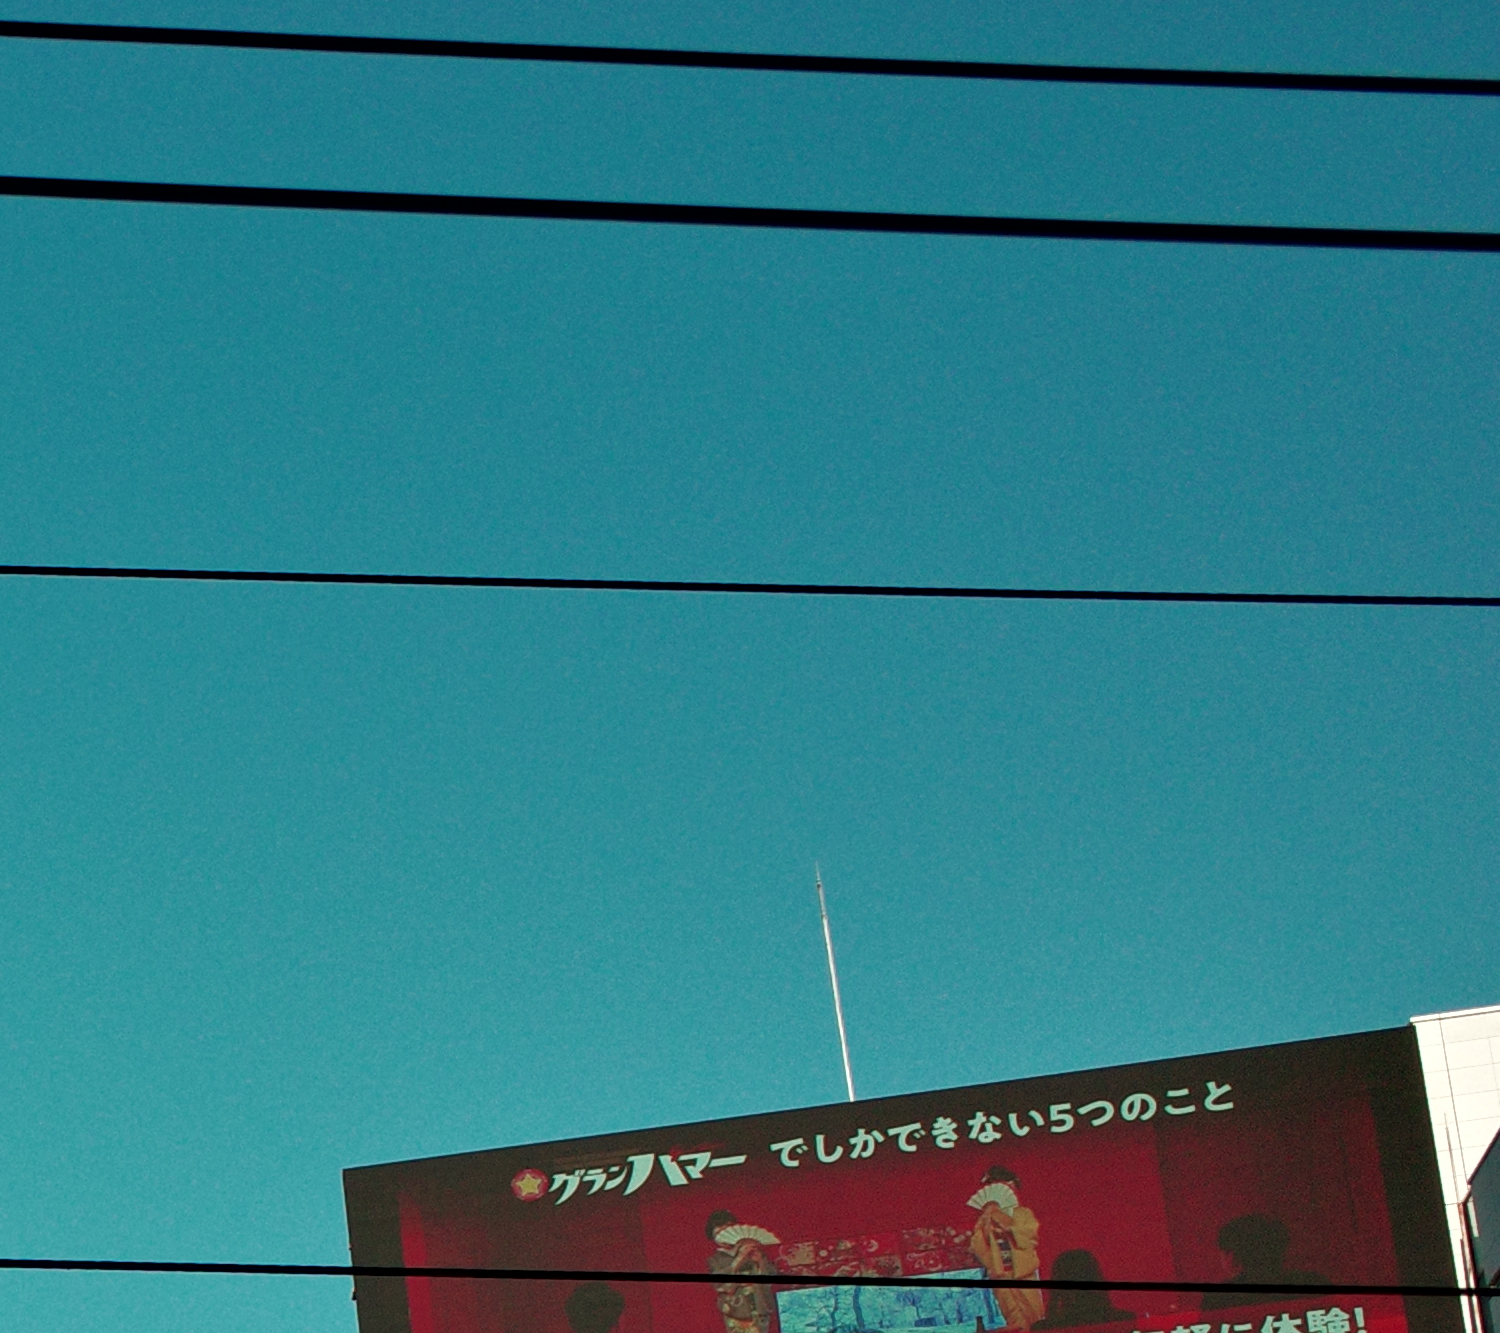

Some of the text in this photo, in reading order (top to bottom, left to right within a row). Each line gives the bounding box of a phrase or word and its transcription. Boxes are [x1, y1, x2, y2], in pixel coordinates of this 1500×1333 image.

[770, 1079, 1235, 1171] でしかできない5つのこと
